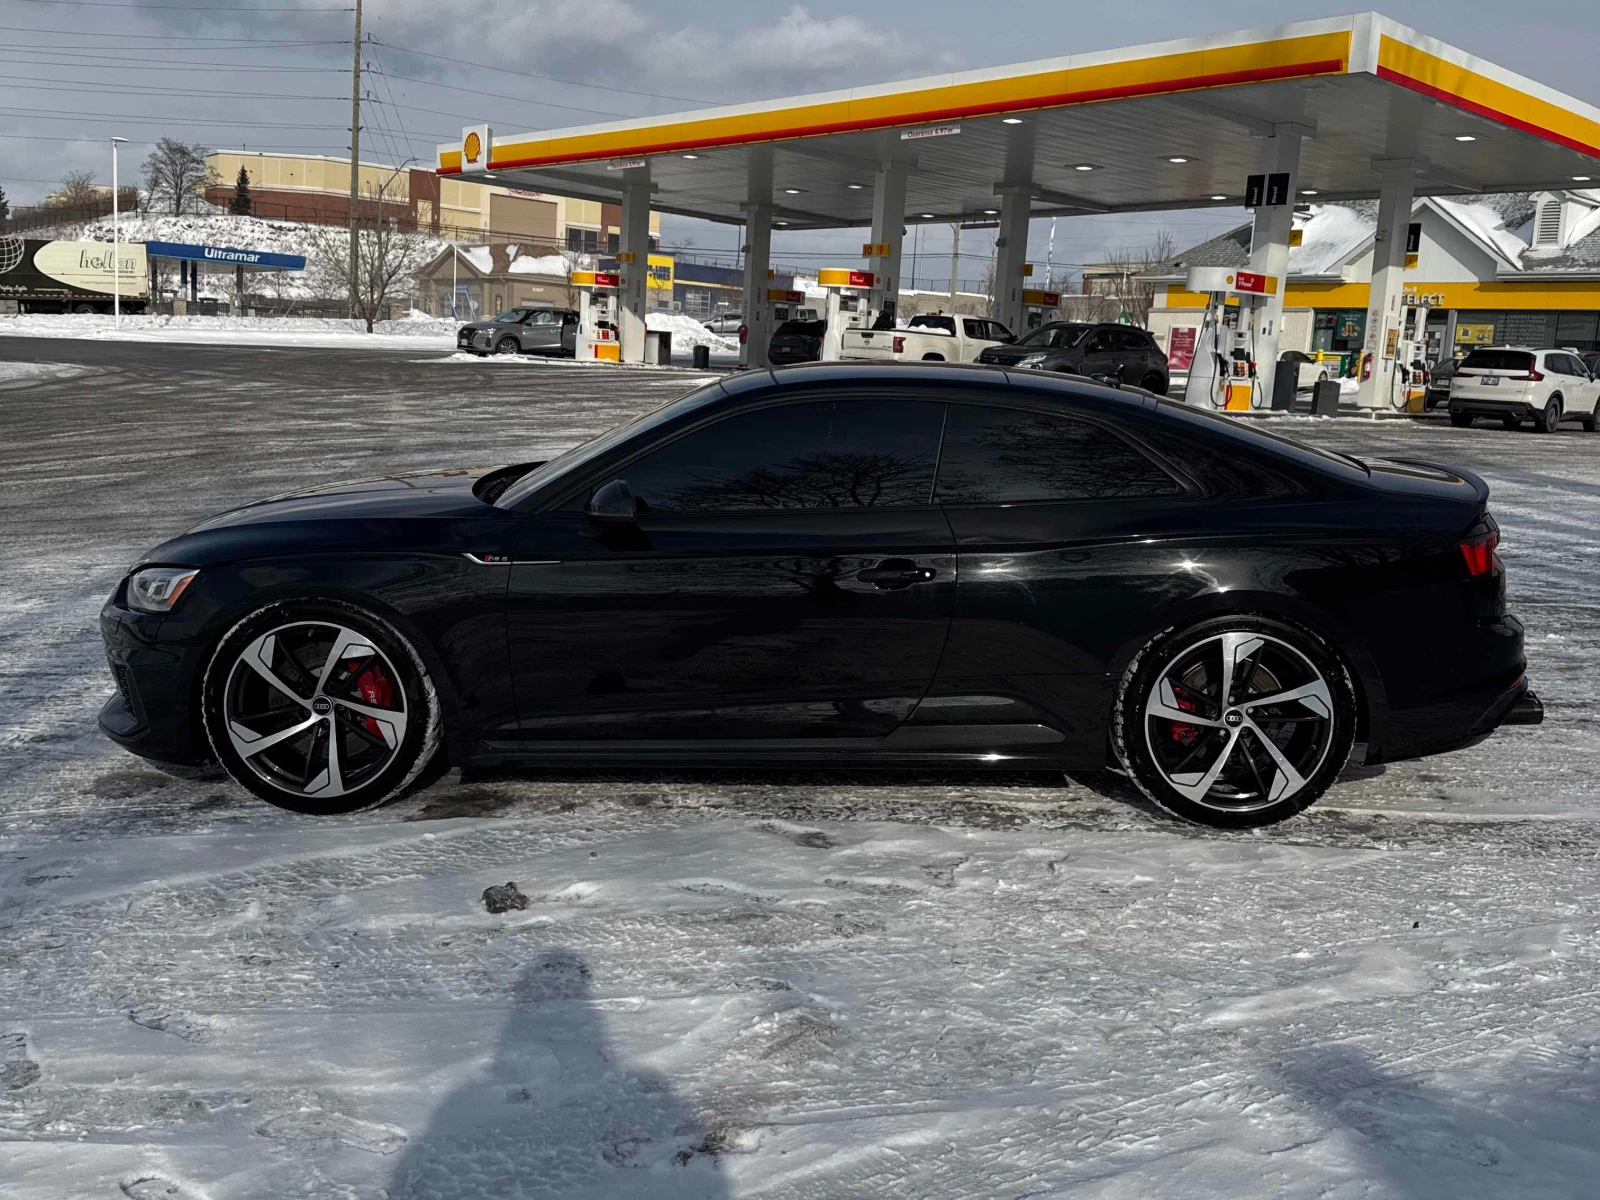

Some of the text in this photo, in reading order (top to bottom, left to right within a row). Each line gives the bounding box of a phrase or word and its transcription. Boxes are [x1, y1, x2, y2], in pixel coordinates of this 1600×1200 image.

[204, 247, 260, 262] Ultramar
[864, 246, 872, 254] 10
[878, 246, 884, 255] 9
